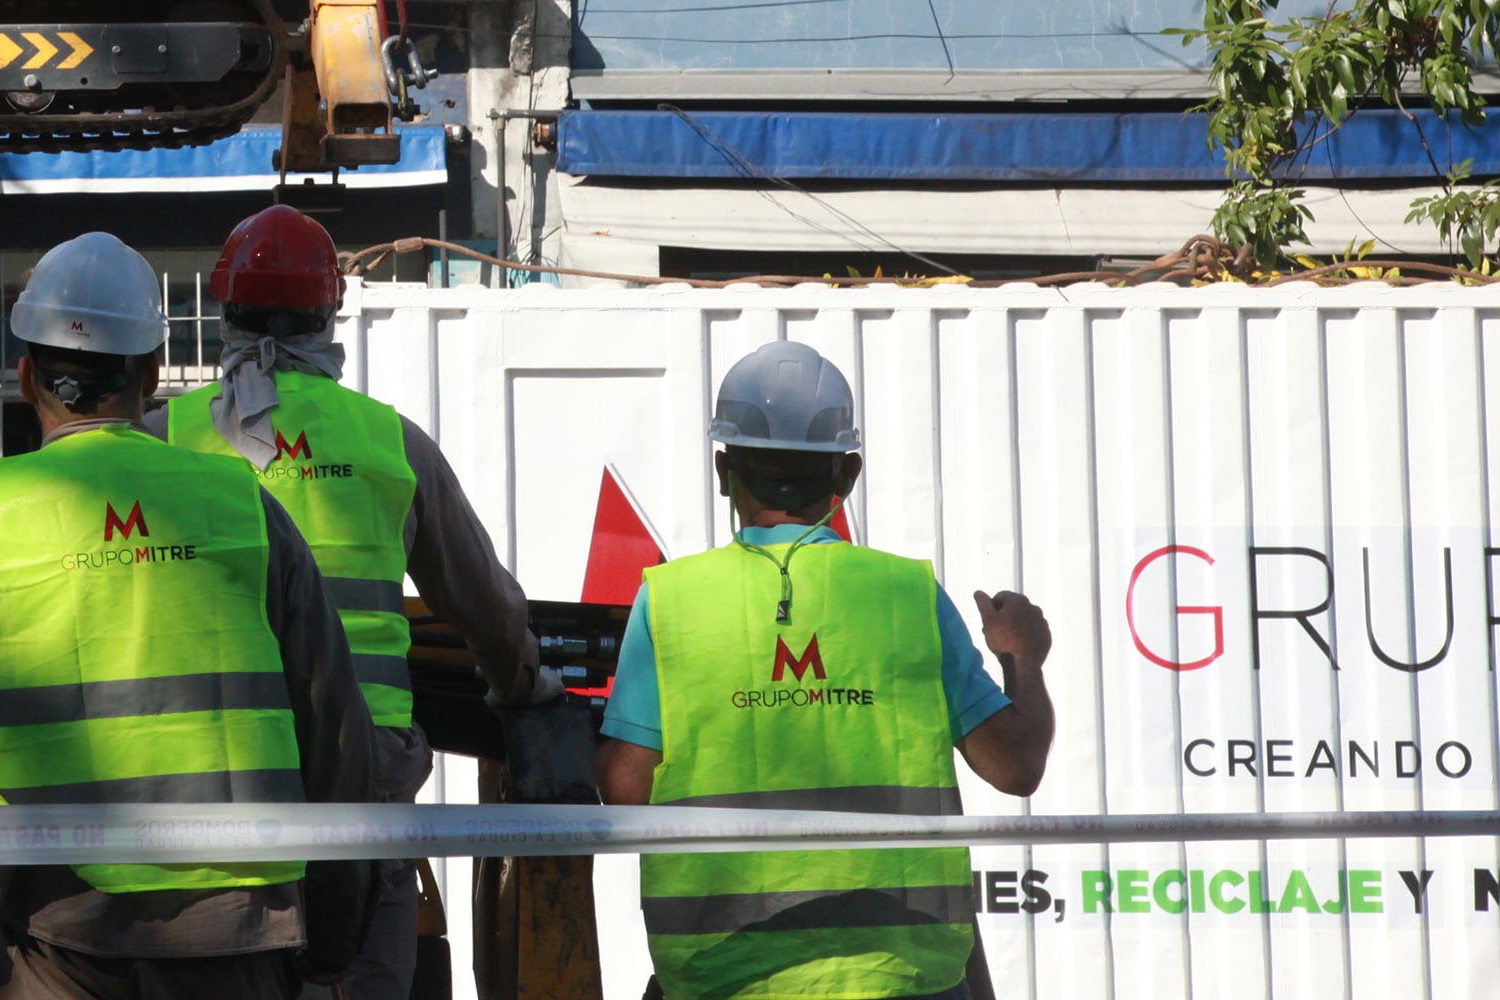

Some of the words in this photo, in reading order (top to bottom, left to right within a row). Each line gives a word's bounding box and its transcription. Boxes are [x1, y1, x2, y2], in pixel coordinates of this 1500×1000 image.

[104, 499, 149, 541] M
[61, 545, 196, 571] GRUPOMITRE
[772, 632, 827, 682] M
[731, 688, 875, 709] GRUPOMITRE
[1184, 738, 1473, 779] CREANDO
[1082, 868, 1384, 915] RECICLAJE
[1400, 870, 1435, 915] Y
